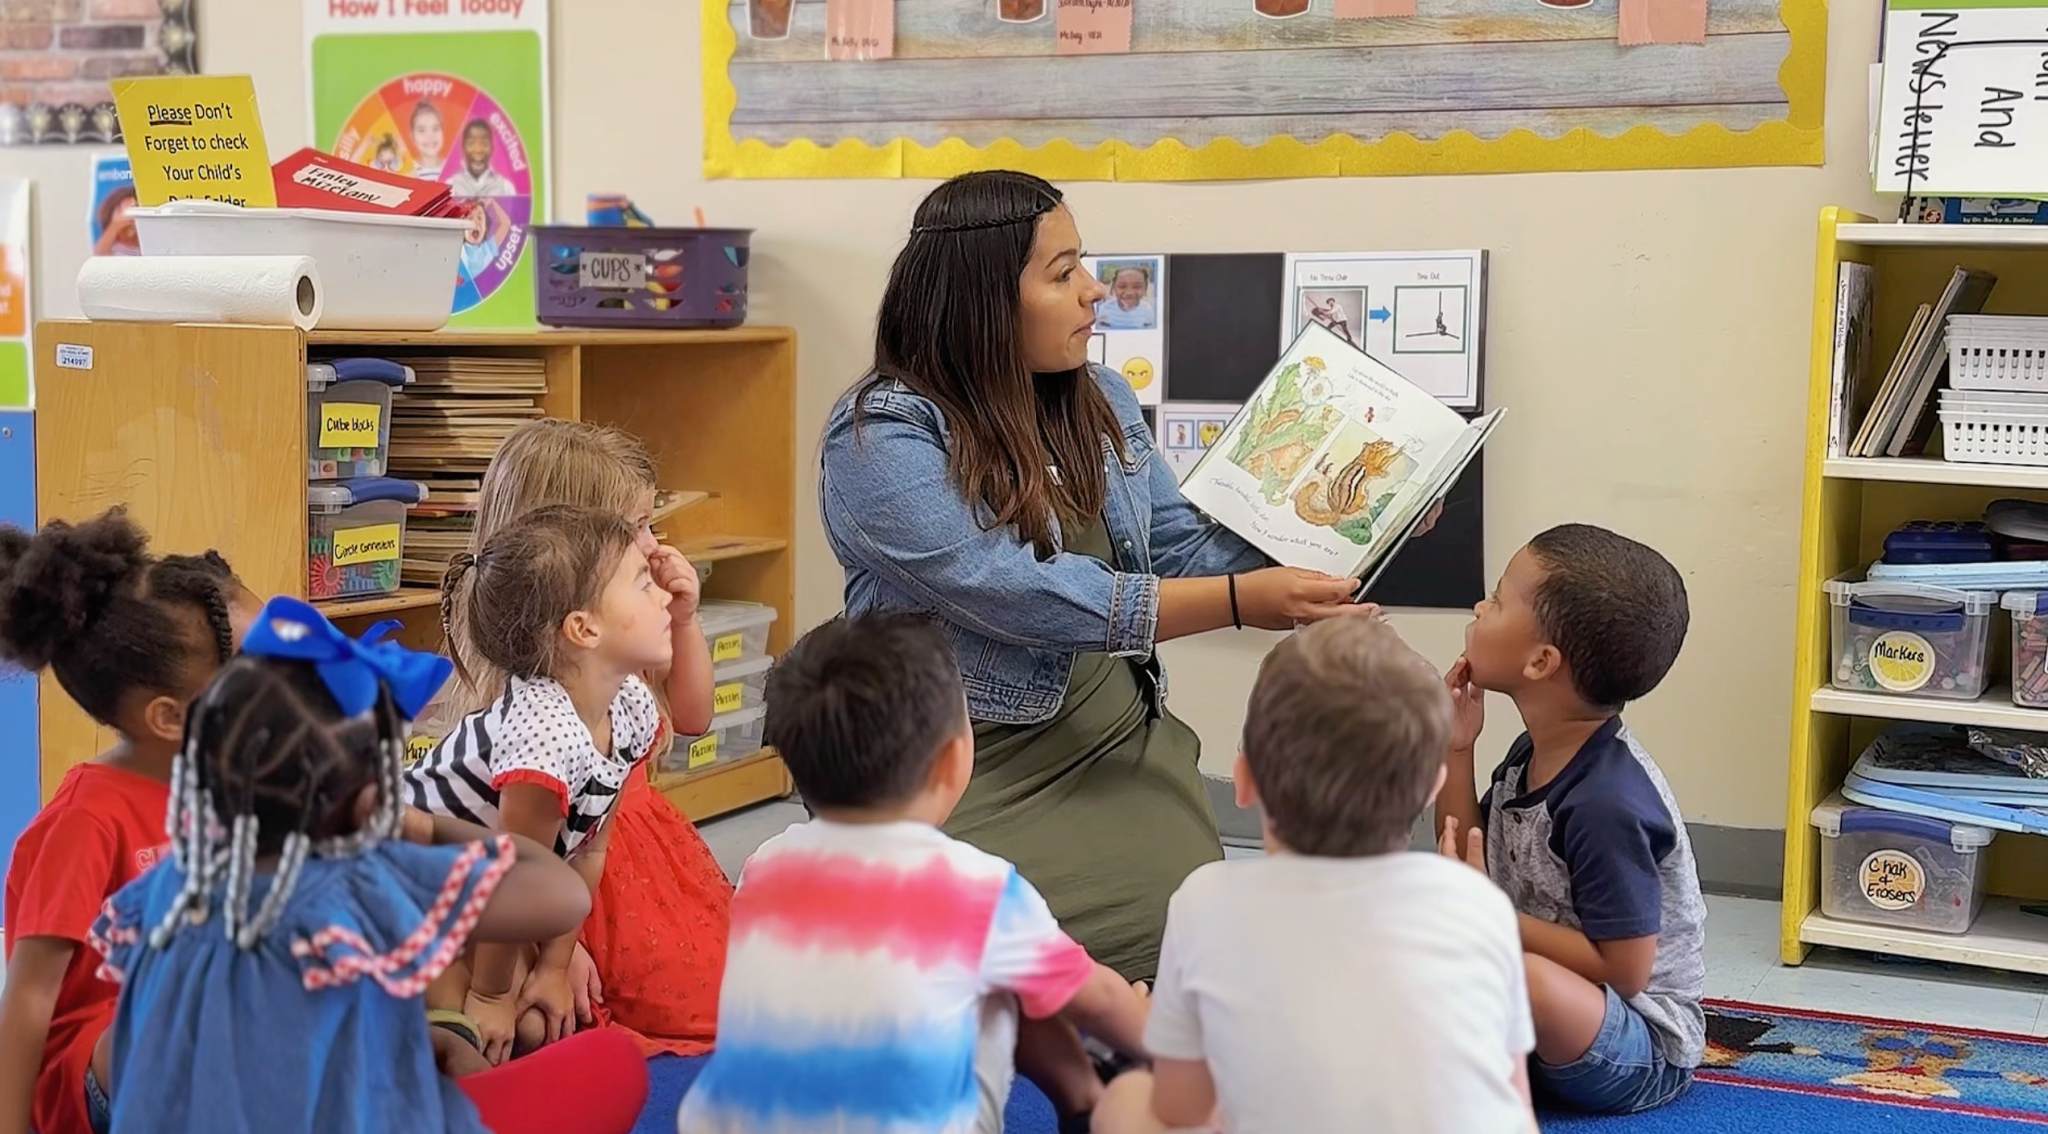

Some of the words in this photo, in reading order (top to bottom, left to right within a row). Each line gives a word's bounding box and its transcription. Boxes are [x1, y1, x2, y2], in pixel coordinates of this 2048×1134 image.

[329, 0, 379, 17] How
[404, 0, 449, 16] Feel
[403, 78, 453, 98] happy
[147, 104, 192, 121] Please
[195, 103, 233, 119] Don't
[1974, 87, 2024, 147] And
[145, 135, 189, 154] Forget
[192, 137, 207, 150] to
[209, 133, 249, 150] check
[338, 126, 361, 160] silly
[489, 112, 527, 172] excited
[162, 165, 194, 181] Your
[198, 163, 242, 181] Child's
[309, 167, 358, 188] Finley
[495, 224, 523, 271] upset
[591, 257, 631, 282] CUPS
[327, 417, 350, 432] Cube
[352, 417, 374, 432] blocks
[335, 544, 358, 559] Circle
[691, 743, 715, 758] Puzzles
